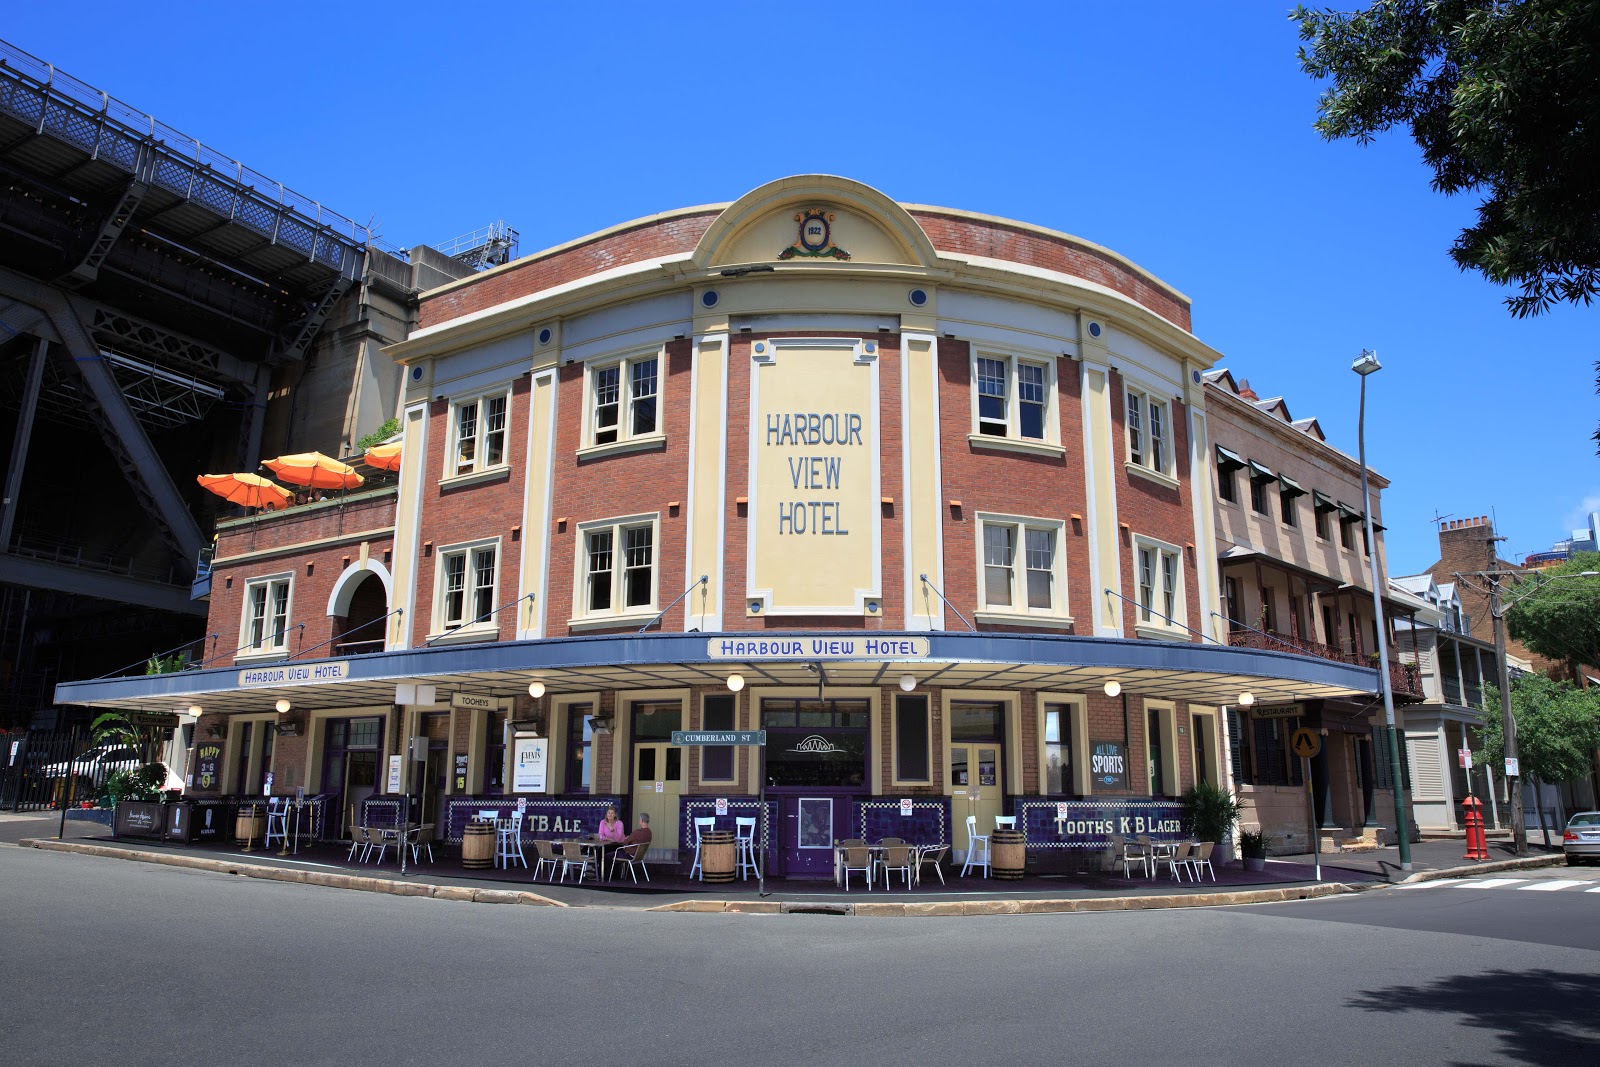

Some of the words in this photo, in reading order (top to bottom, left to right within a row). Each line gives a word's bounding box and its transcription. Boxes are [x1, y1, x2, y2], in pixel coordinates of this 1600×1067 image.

[808, 227, 821, 235] 1922
[767, 413, 862, 446] HARBOUR
[788, 456, 841, 489] VIEW
[779, 501, 849, 535] HOTEL
[721, 640, 804, 655] HARBOUR
[812, 639, 854, 655] VIEW
[865, 639, 918, 655] HOTEL
[245, 670, 284, 683] HARBOUR
[288, 668, 310, 680] VIEW
[315, 665, 342, 679] HOTEL
[462, 697, 489, 706] TOOHEYS
[1256, 706, 1298, 716] RESTAURANT
[137, 715, 173, 724] RESTAURANT
[685, 734, 736, 742] CUMBERLAND
[741, 734, 751, 742] ST
[200, 746, 220, 759] HAPPY
[1096, 744, 1105, 756] ALL
[1092, 754, 1124, 773] SPORTS
[553, 815, 581, 833] ALE
[1053, 817, 1113, 834] TOOTH'S
[1148, 816, 1181, 833] LAGER
